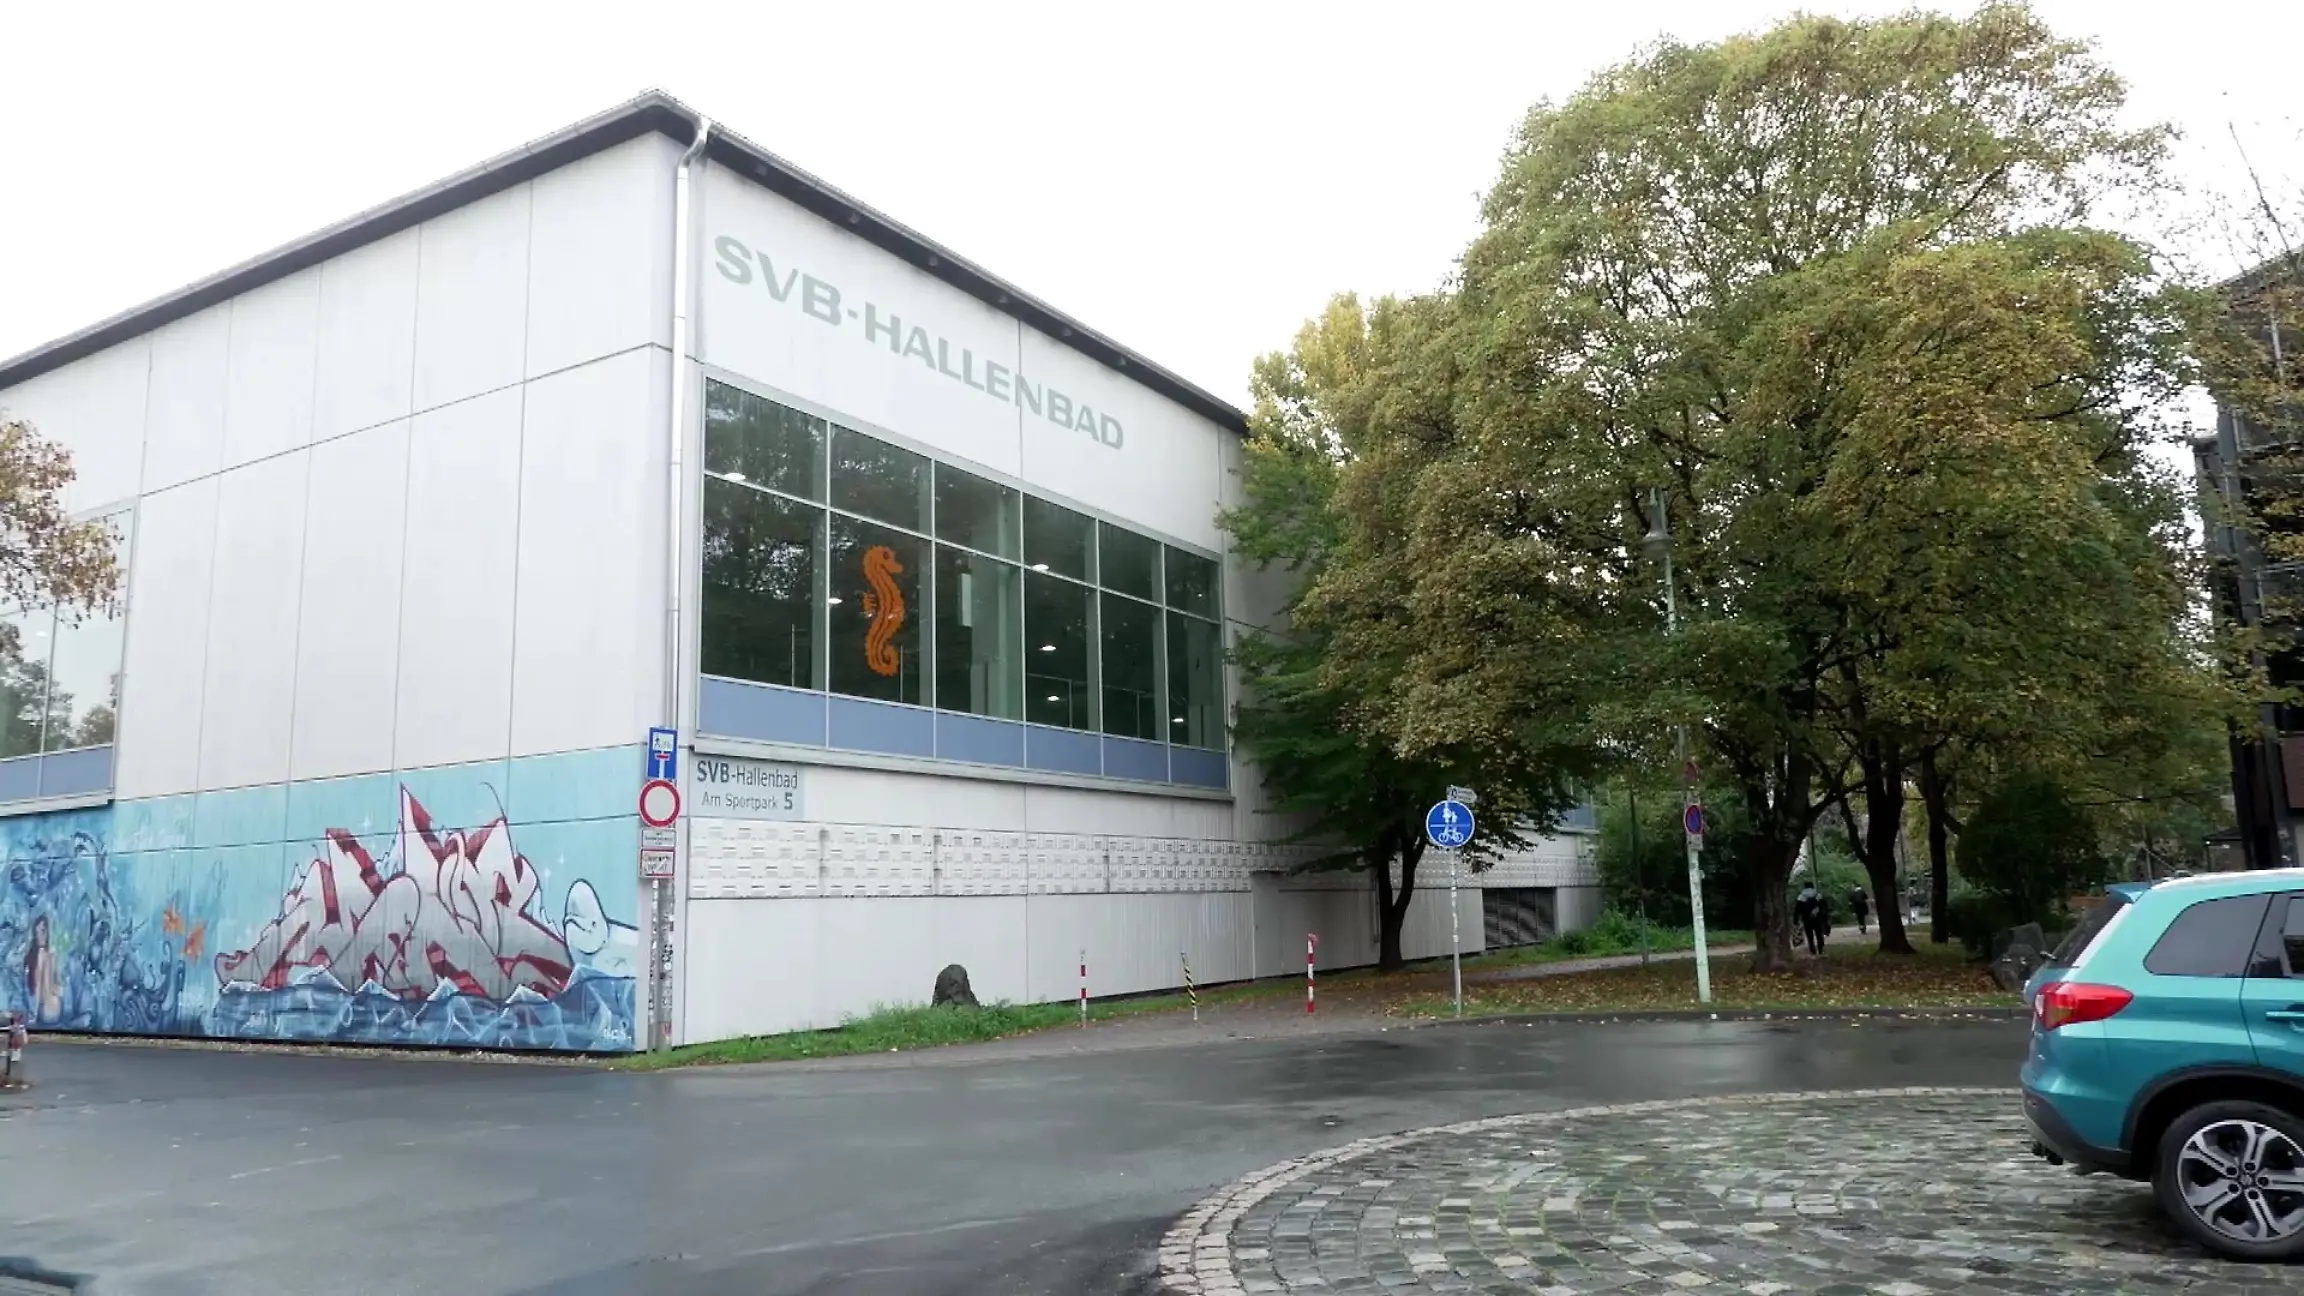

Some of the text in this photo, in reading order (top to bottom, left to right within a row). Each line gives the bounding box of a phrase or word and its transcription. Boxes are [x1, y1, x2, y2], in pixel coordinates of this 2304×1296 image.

[714, 234, 1124, 450] SVB-HALLENBAD
[697, 760, 797, 789] SVB-Hallenbad
[701, 791, 793, 812] Am Sportpark 5
